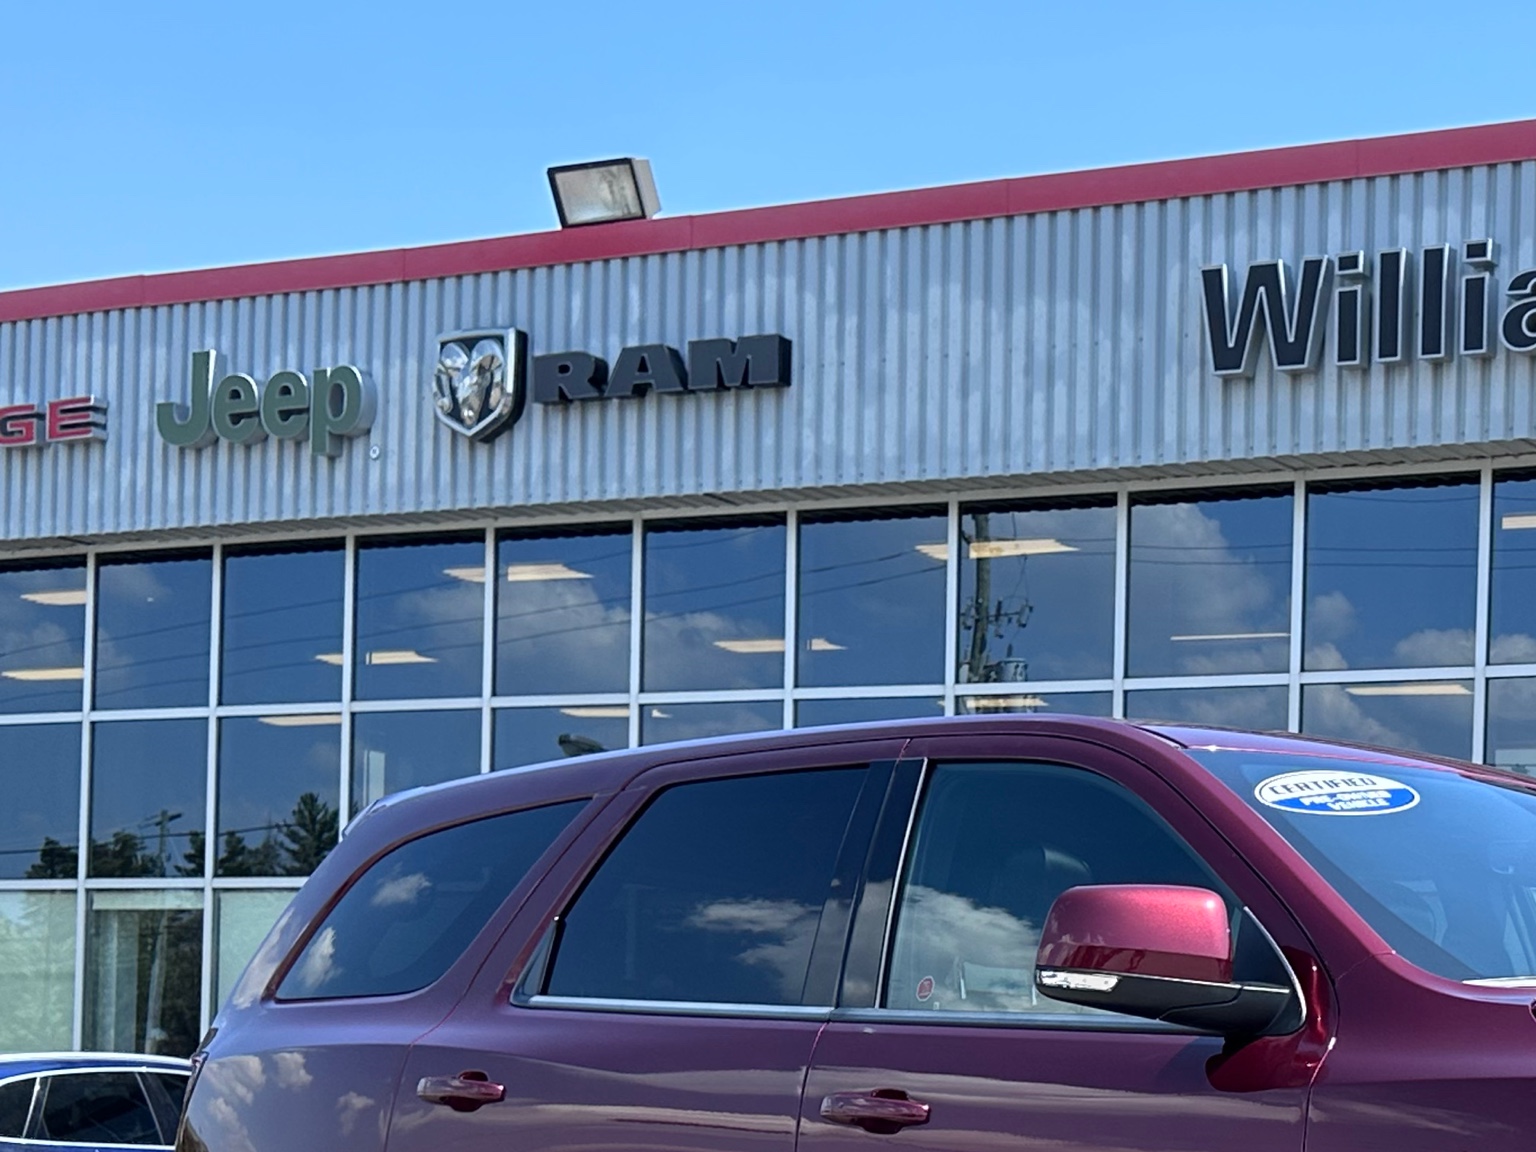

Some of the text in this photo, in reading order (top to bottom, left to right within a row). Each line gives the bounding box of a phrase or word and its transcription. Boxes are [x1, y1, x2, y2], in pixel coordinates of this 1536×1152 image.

[156, 349, 375, 457] Jeep
[532, 334, 792, 406] RAM
[1268, 778, 1378, 795] CERTIFIED
